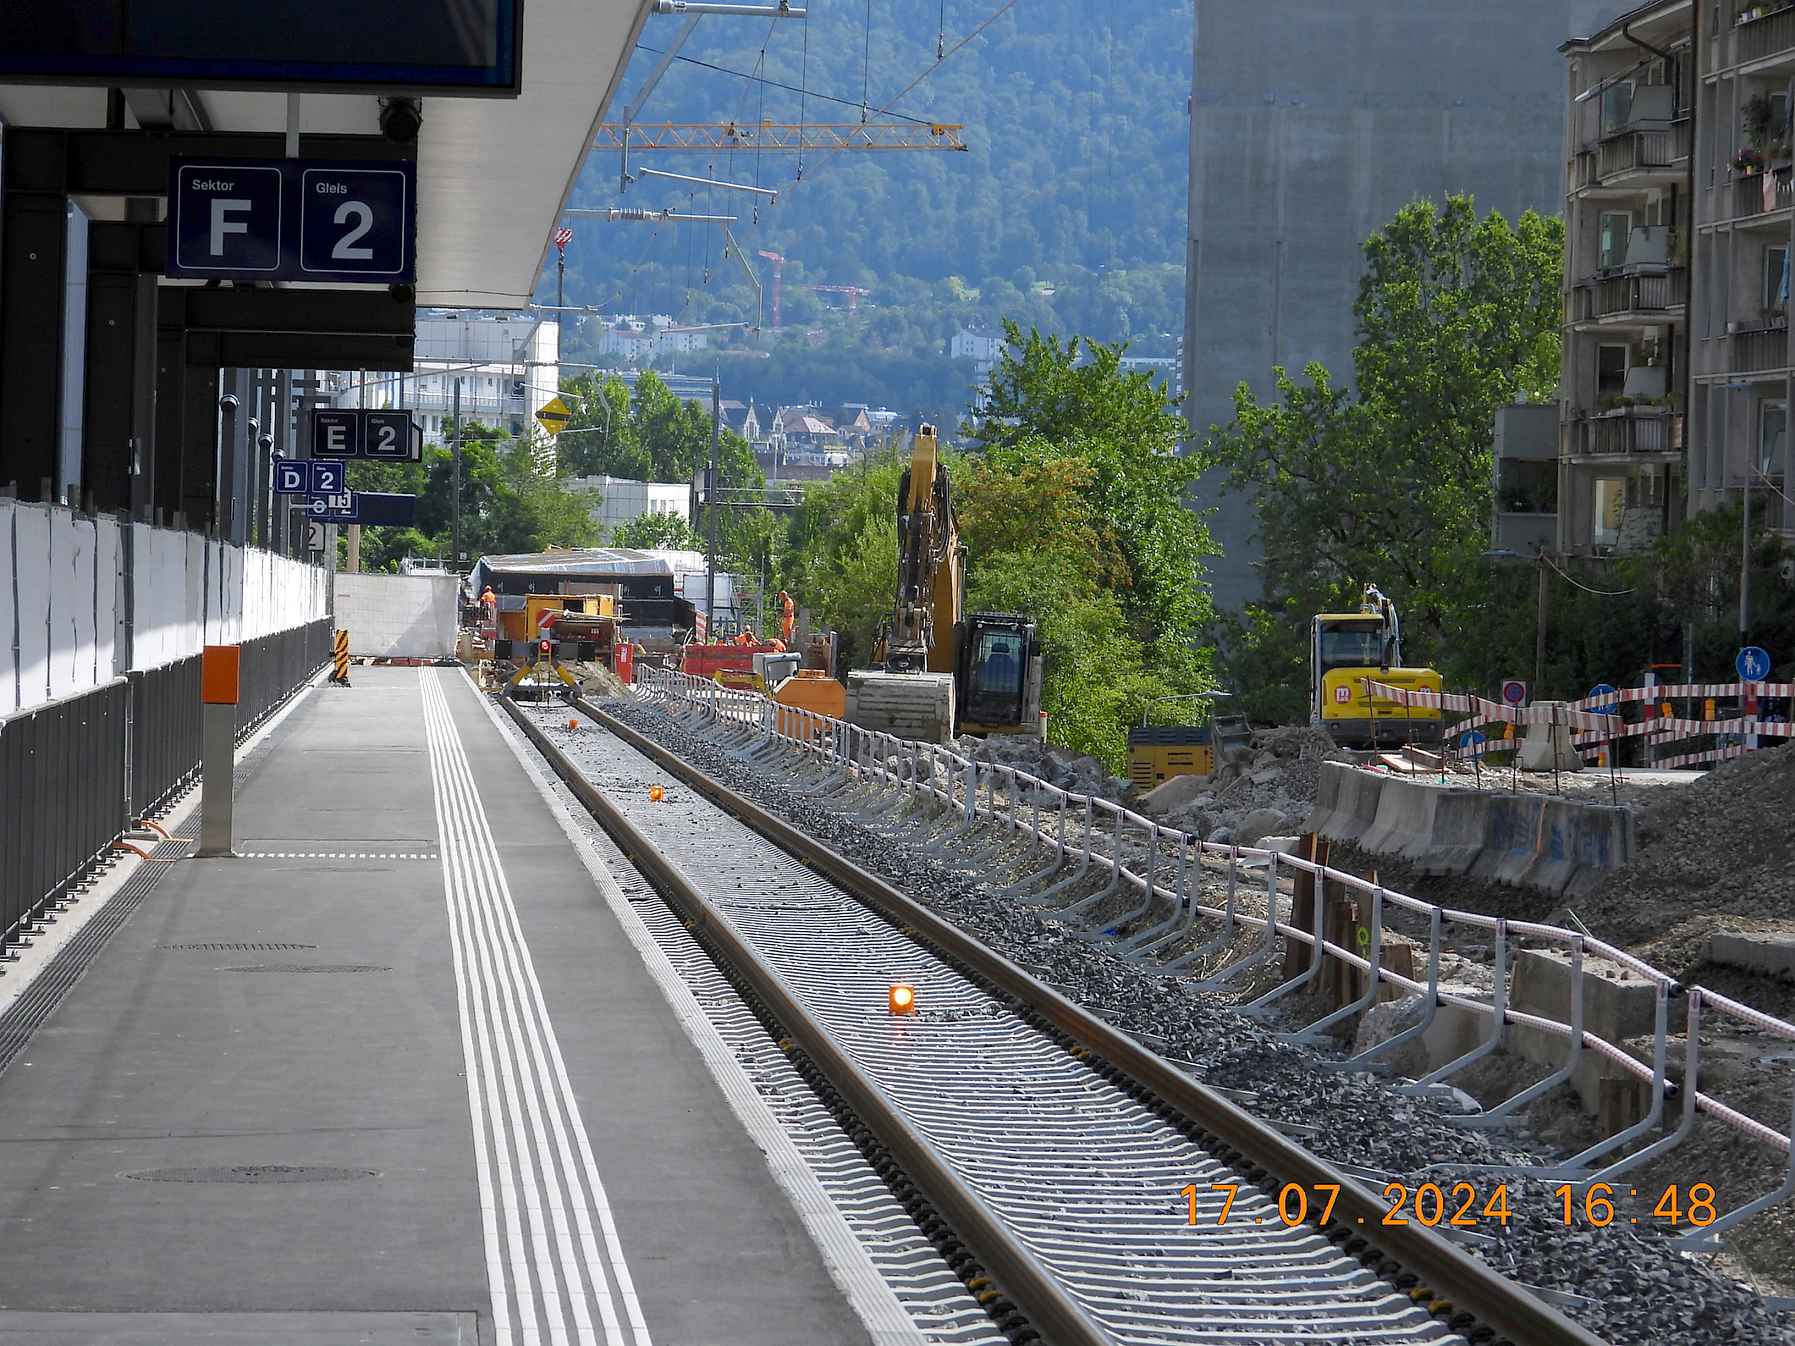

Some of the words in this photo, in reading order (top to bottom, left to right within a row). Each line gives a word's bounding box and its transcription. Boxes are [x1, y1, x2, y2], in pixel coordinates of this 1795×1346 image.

[191, 179, 235, 192] Sektor
[316, 182, 348, 195] Gleis
[209, 198, 252, 256] F
[331, 200, 374, 260] 2
[327, 425, 346, 450] E
[377, 425, 396, 451] 2
[284, 471, 300, 488] D
[320, 471, 334, 489] 2
